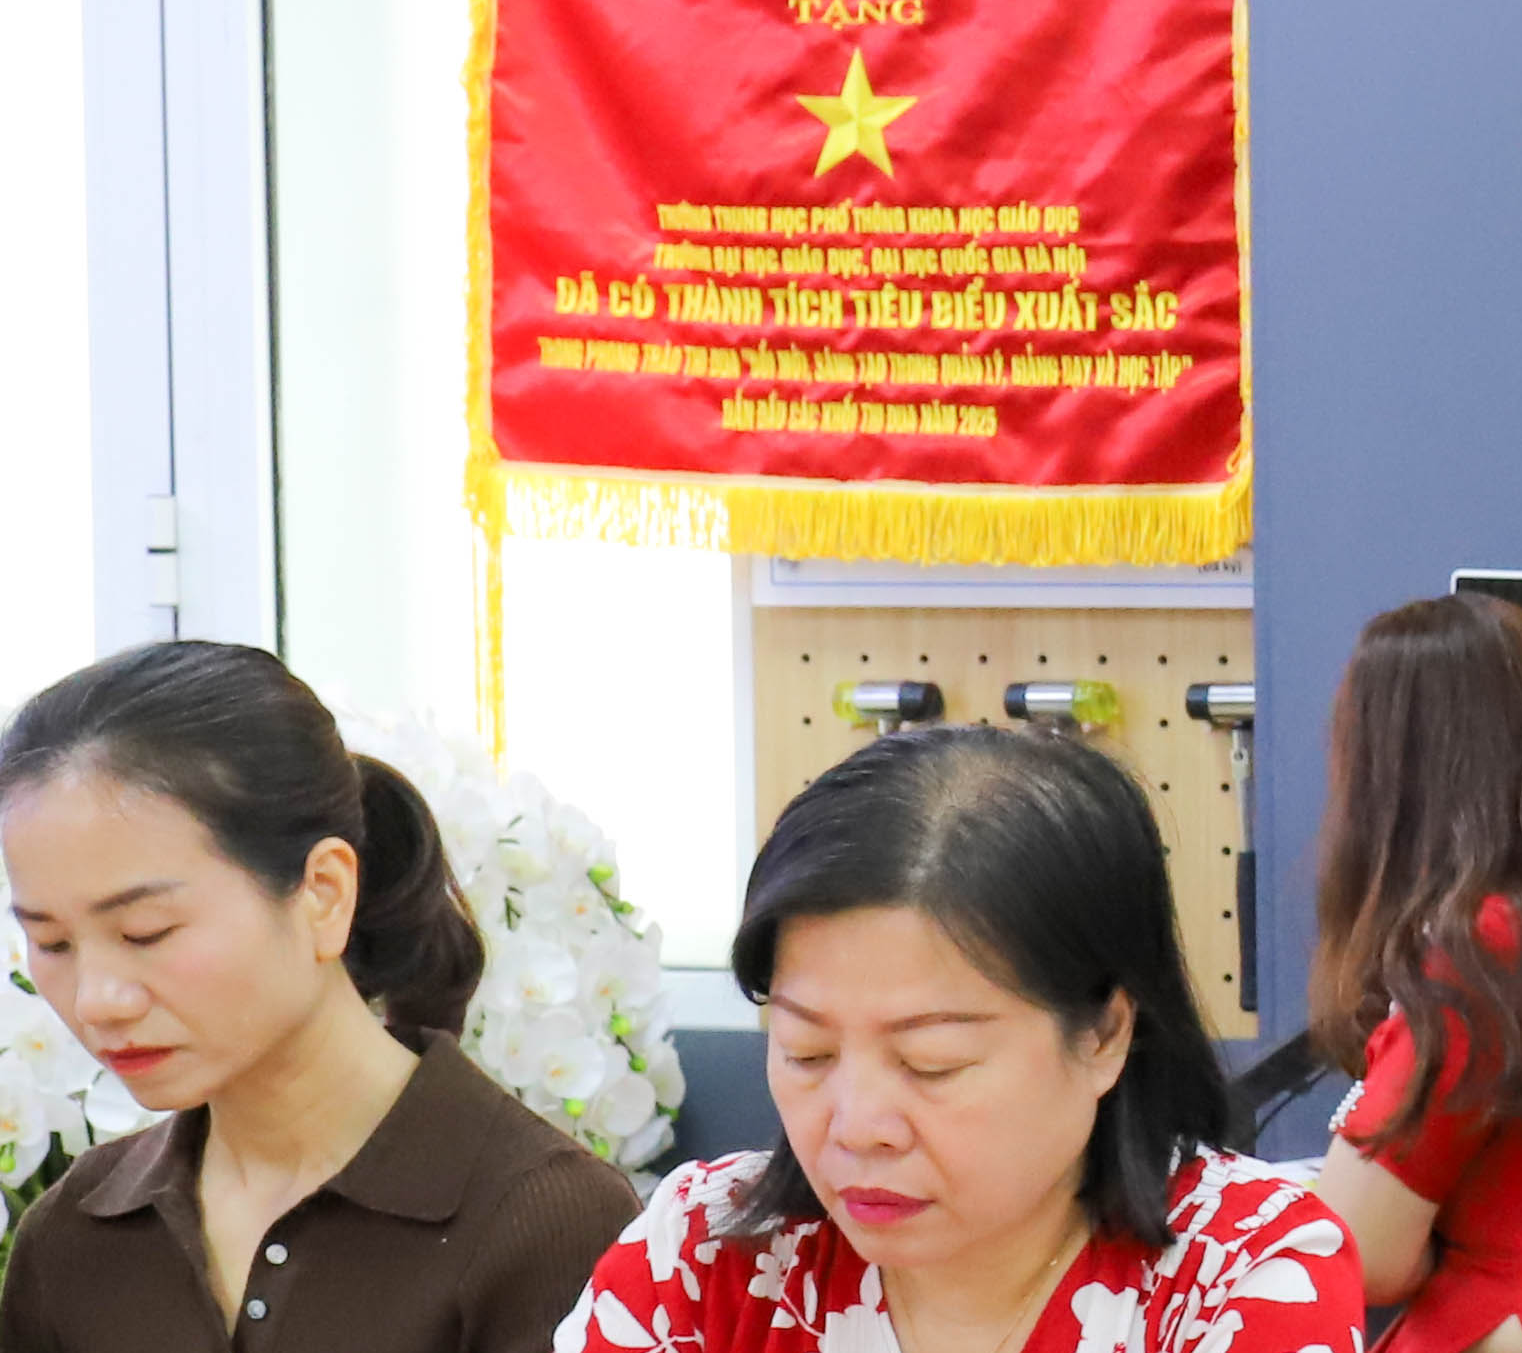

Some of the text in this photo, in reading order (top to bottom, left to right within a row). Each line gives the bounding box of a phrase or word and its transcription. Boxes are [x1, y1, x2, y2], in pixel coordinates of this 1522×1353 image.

[770, 206, 808, 238] HỌC
[959, 206, 995, 238] HỌC
[997, 200, 1041, 233] GIÁO
[1044, 206, 1080, 238] DỤC
[744, 246, 780, 279] HỌC
[555, 271, 1178, 332] ĐÃ CÓ THÀNH TÍCH TIÊU BIỂU XUẤT SẮC
[958, 404, 997, 437] 2025
